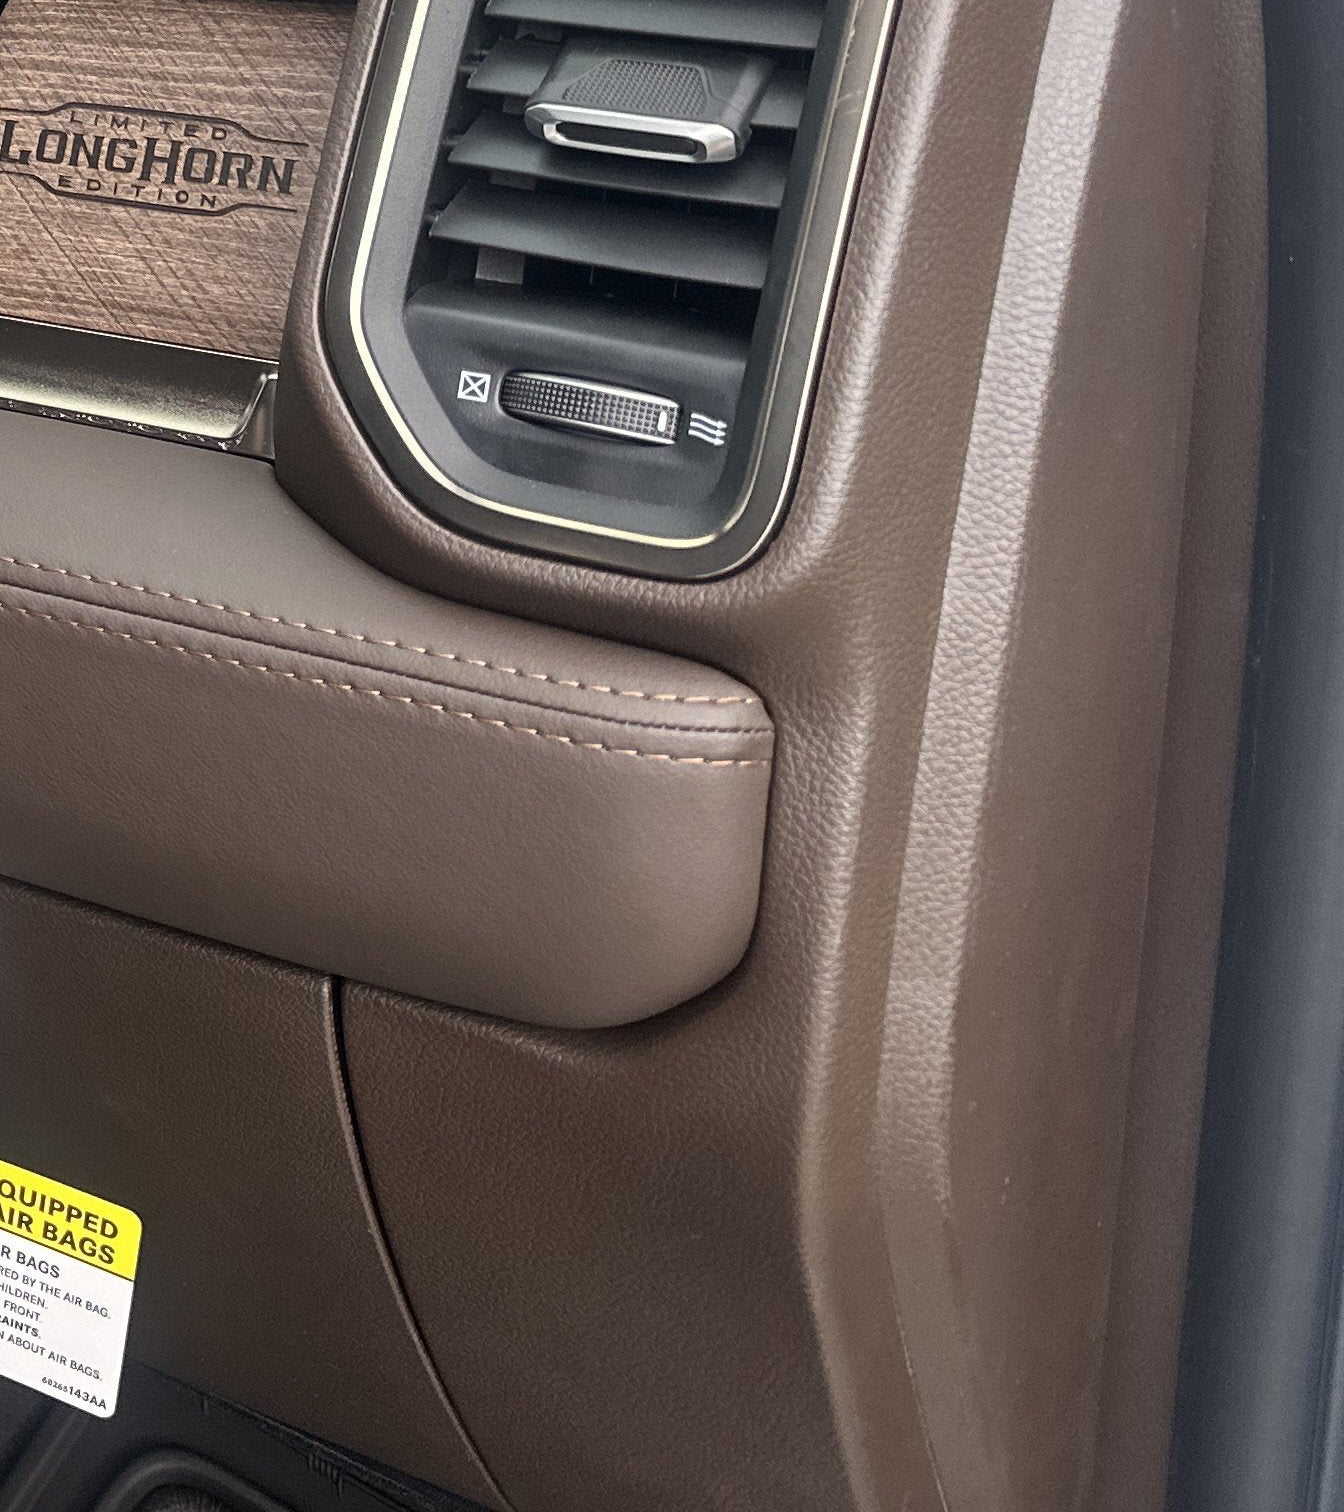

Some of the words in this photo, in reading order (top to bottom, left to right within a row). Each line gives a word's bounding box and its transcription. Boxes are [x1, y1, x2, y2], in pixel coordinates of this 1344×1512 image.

[69, 111, 229, 142] LIMITED
[56, 174, 218, 208] EDITION
[42, 1221, 115, 1265] BAGS
[16, 1250, 60, 1279] BAGS
[3, 1299, 41, 1322] FRONT.
[21, 1274, 37, 1288] BY
[39, 1280, 62, 1299] THE
[62, 1292, 83, 1308] AIR
[85, 1300, 112, 1320] BAG.
[6, 1334, 46, 1357] ABOUT
[47, 1350, 68, 1367] AIR
[69, 1359, 102, 1381] BAGS.
